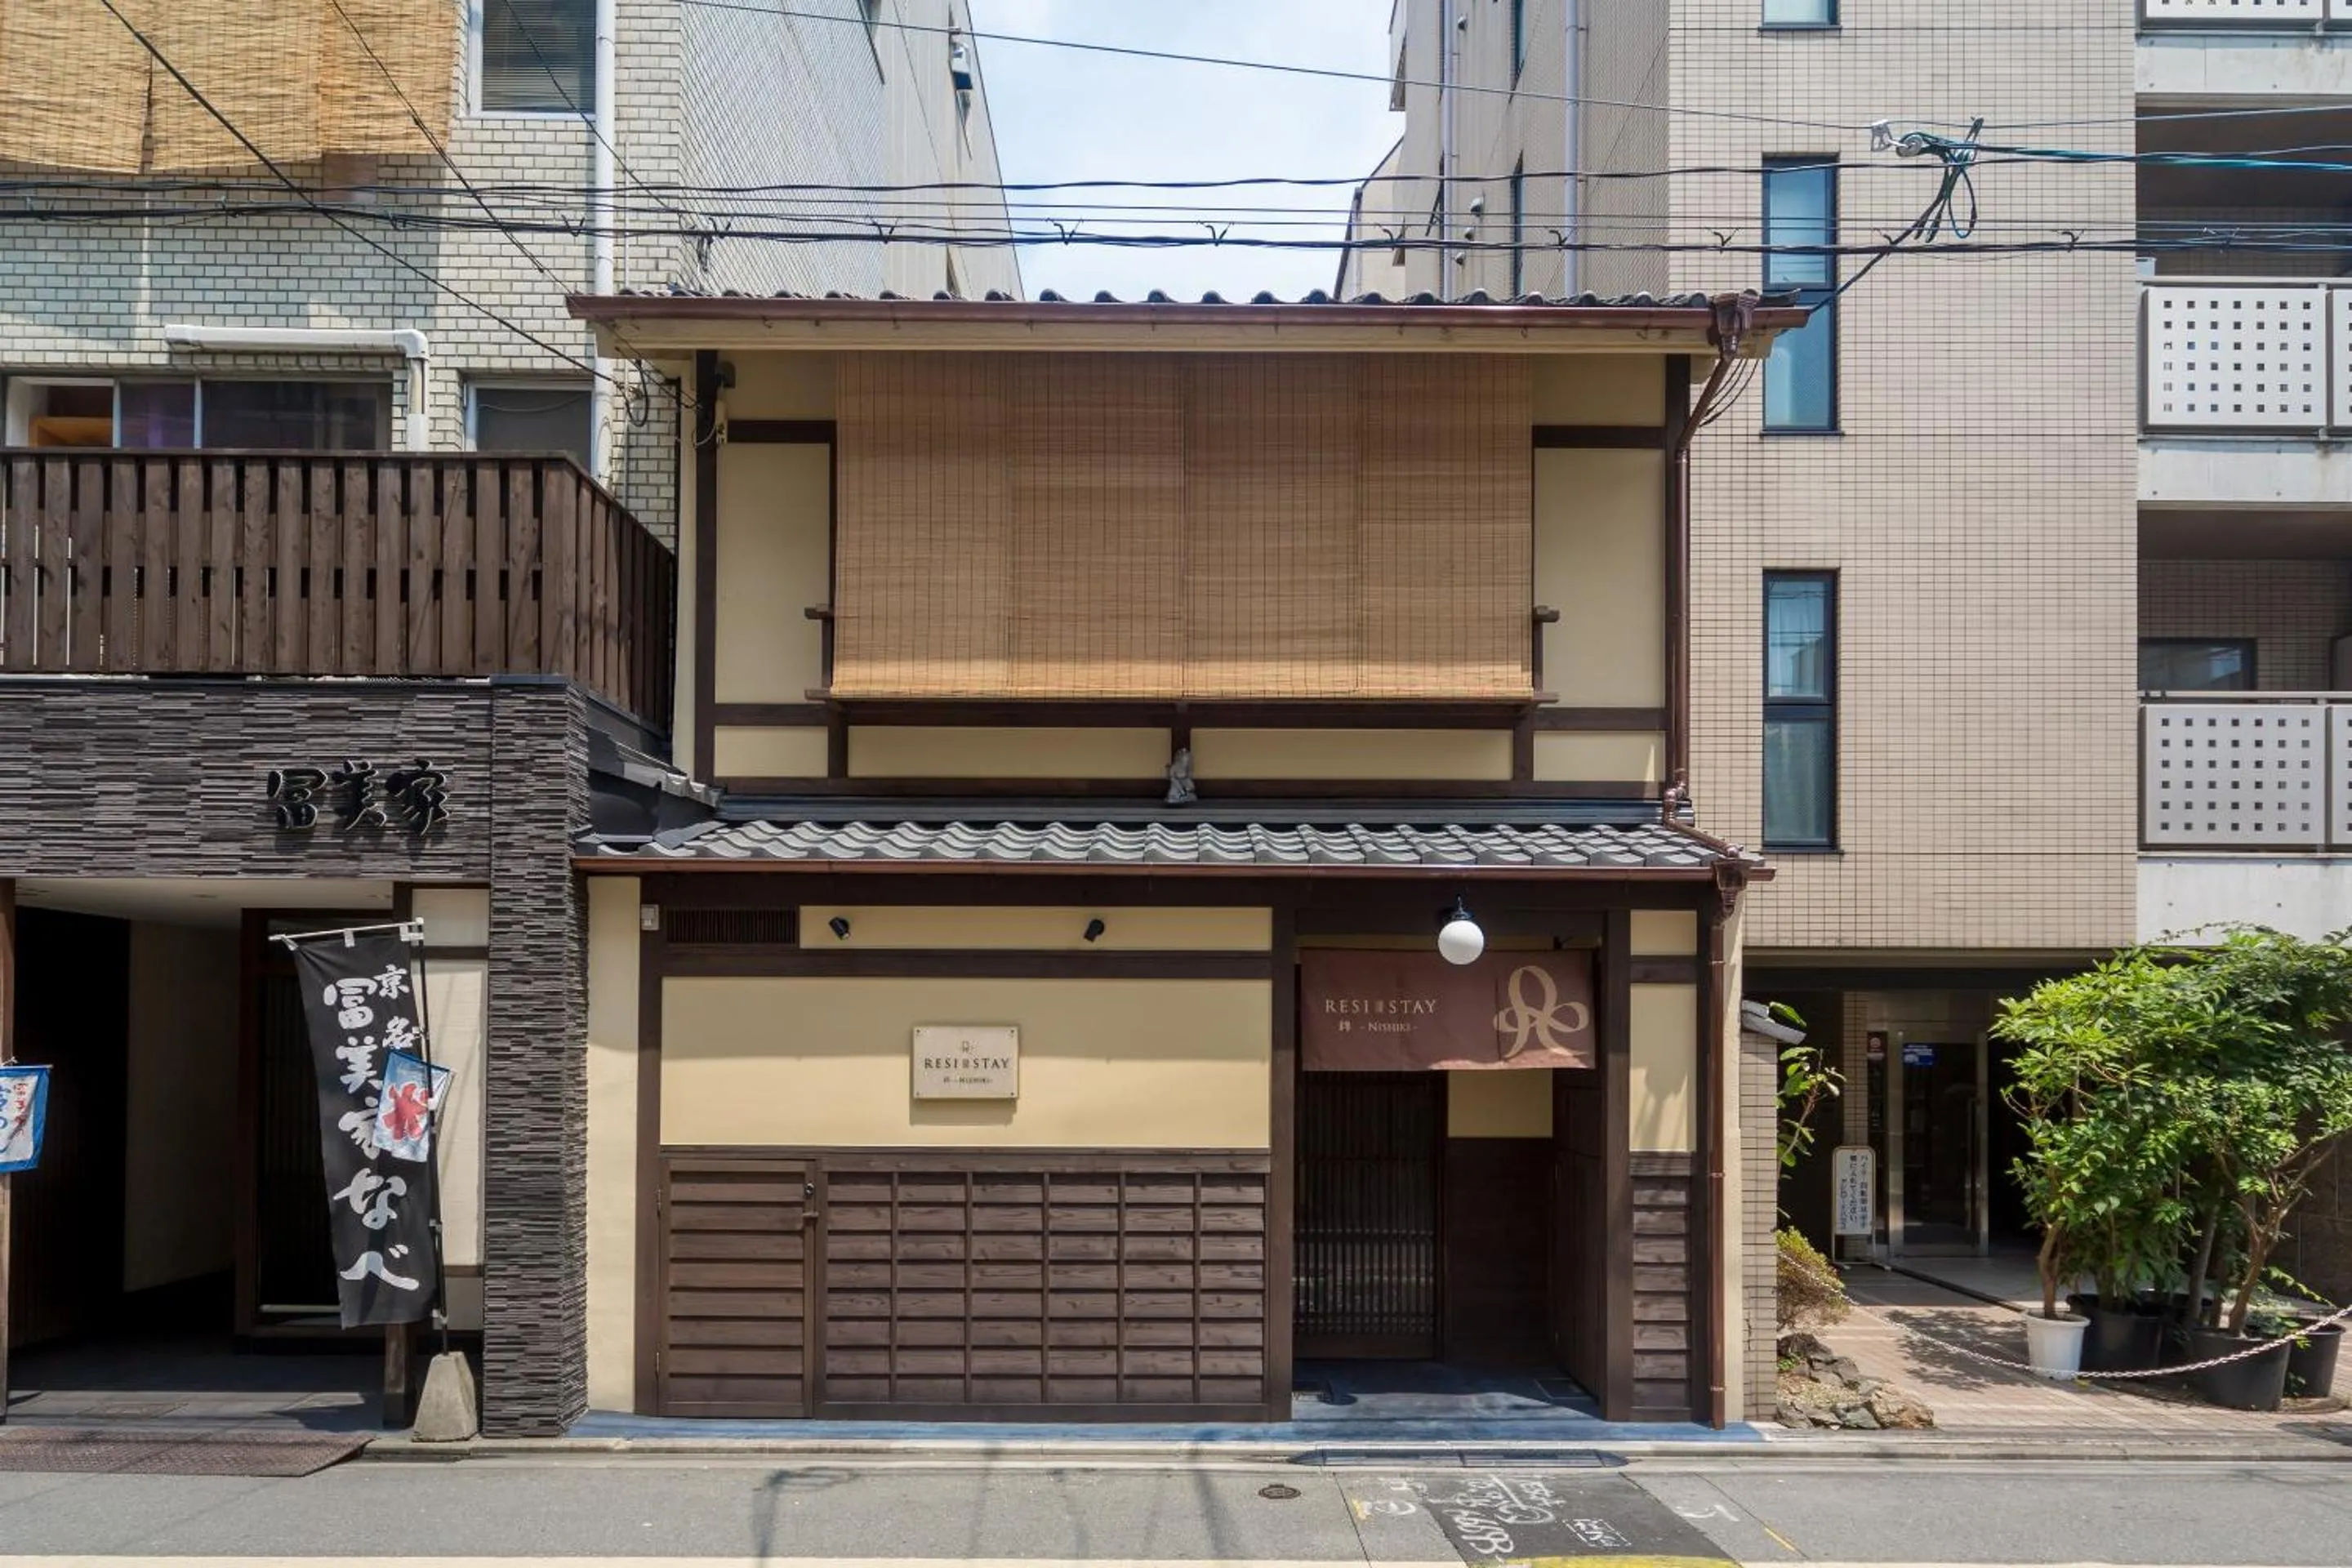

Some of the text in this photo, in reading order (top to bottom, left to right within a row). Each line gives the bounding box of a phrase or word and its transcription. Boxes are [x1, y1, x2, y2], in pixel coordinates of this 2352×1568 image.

[1325, 999, 1436, 1014] RESI STAY
[924, 1058, 1009, 1069] RESI STAY
